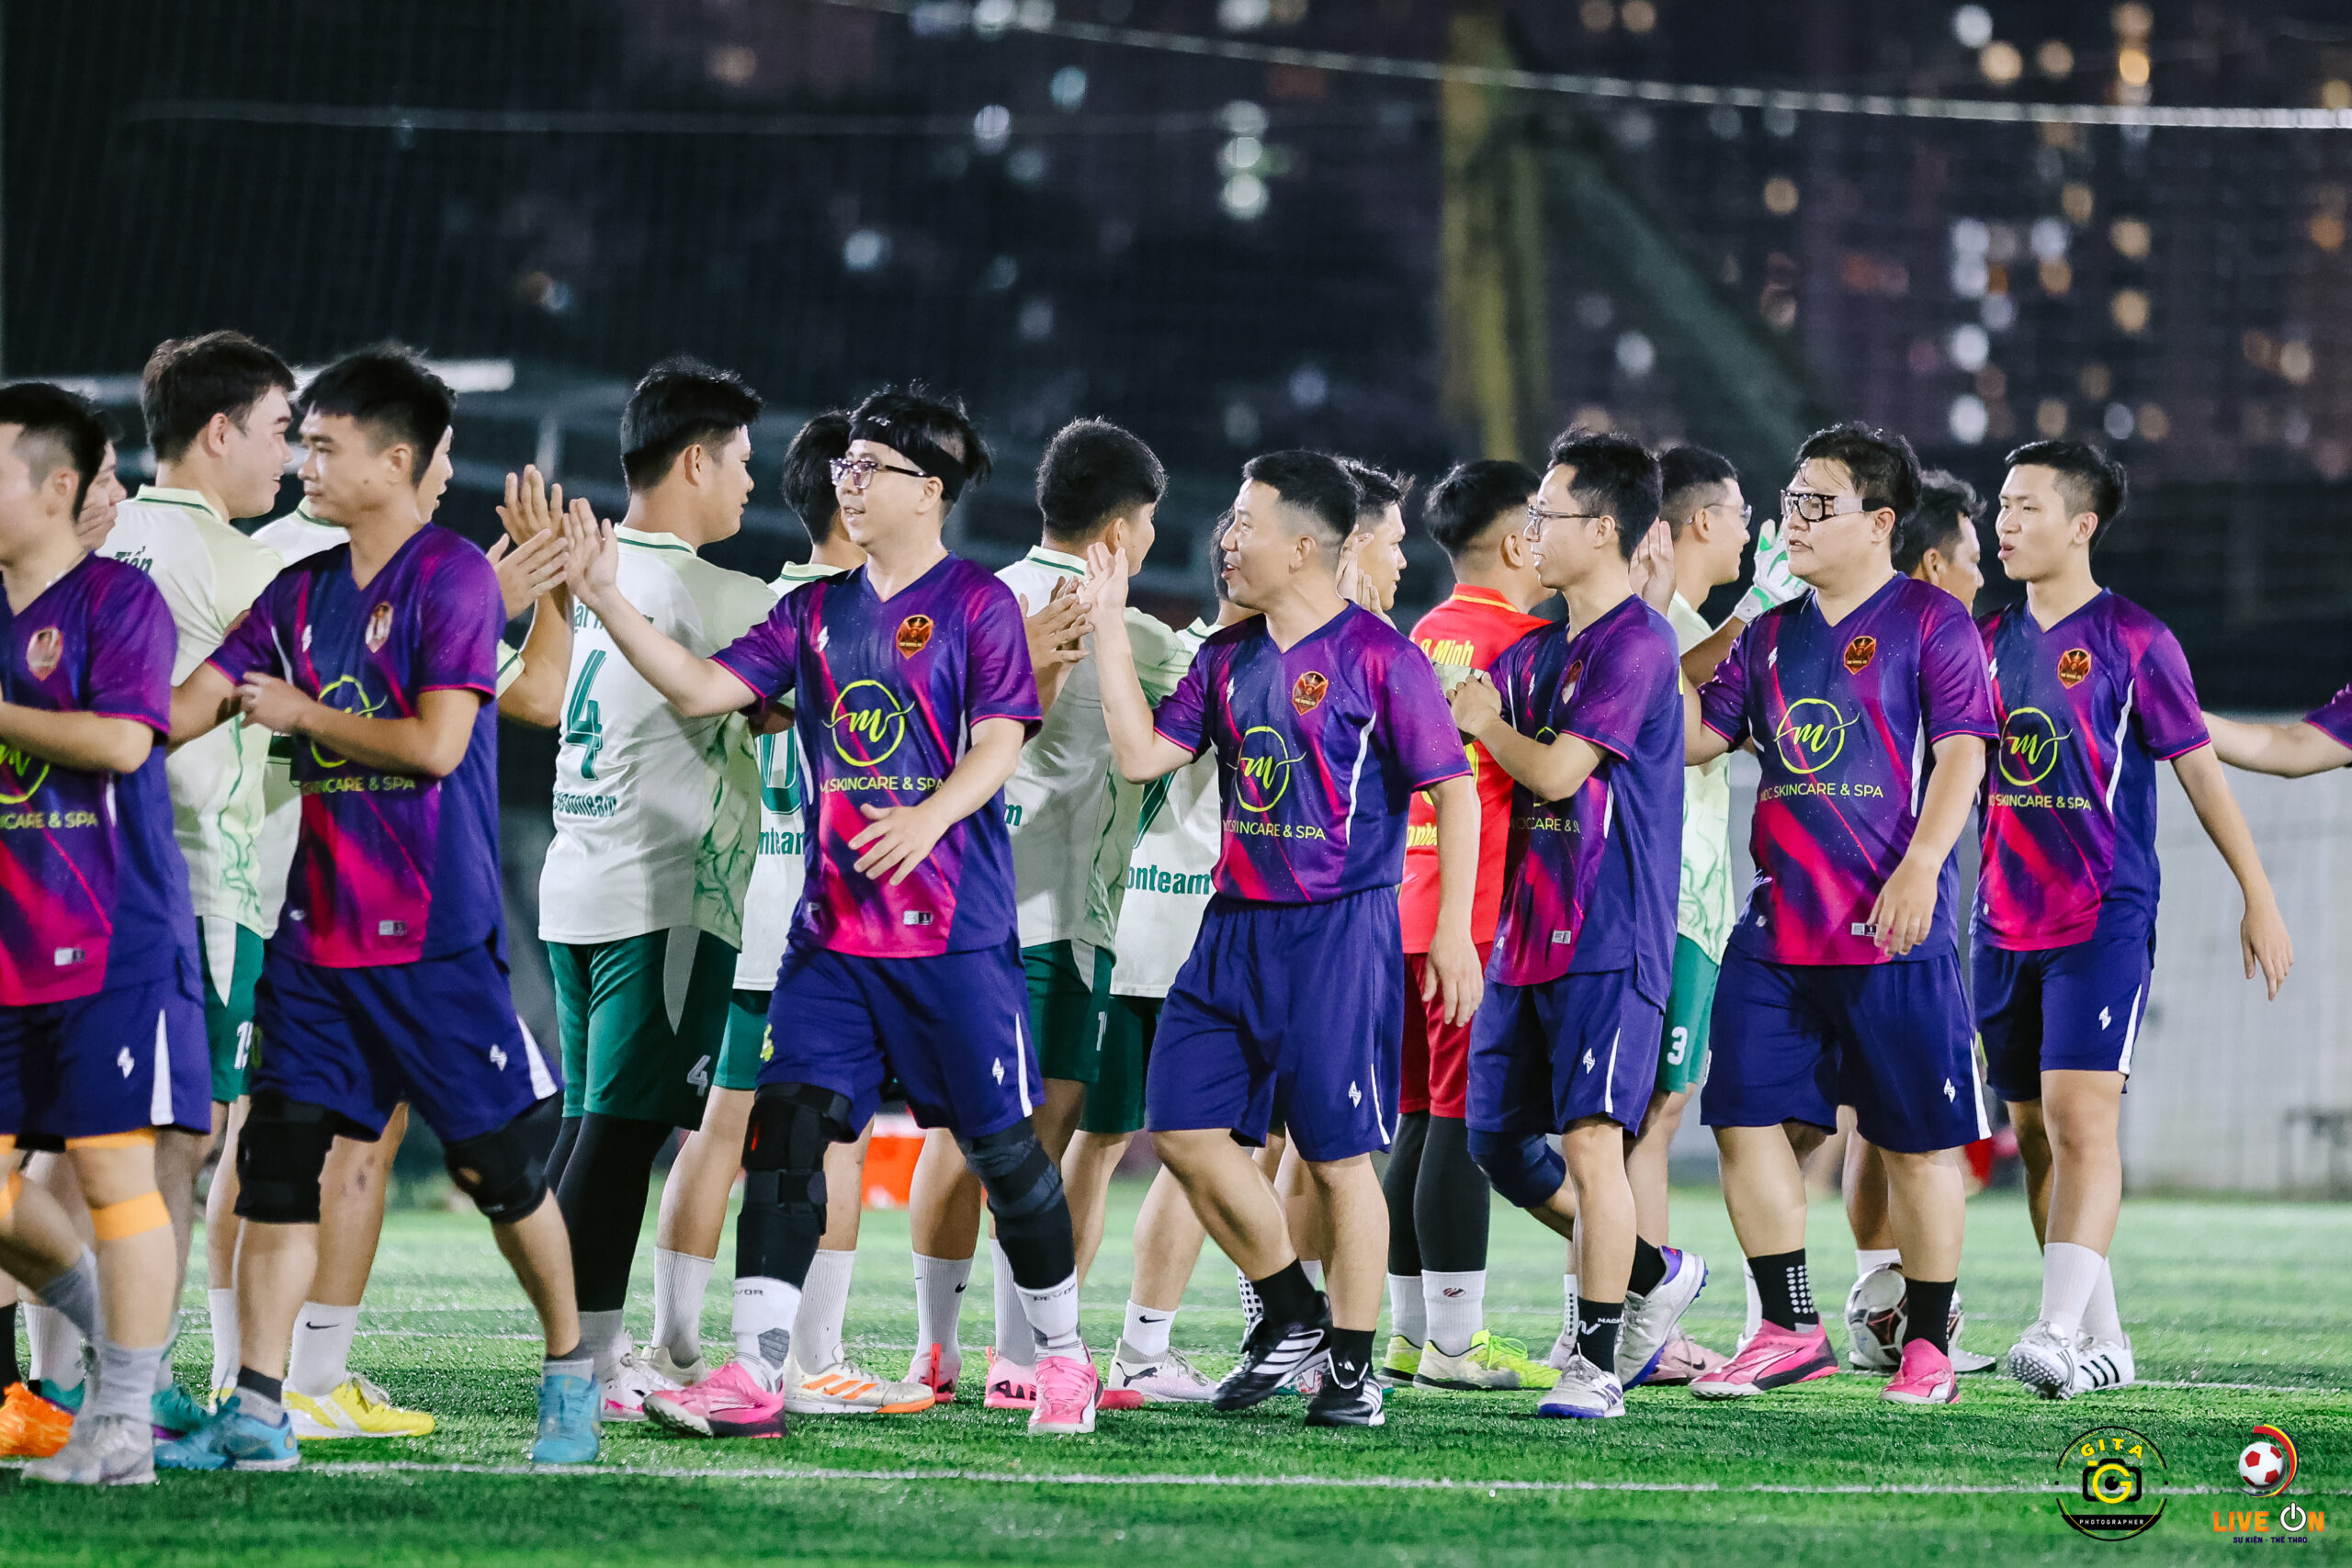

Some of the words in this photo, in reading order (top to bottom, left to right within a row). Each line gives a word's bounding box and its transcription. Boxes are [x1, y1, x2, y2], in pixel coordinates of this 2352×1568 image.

[565, 649, 603, 782] 4
[382, 775, 415, 791] SPA
[830, 776, 899, 793] SKINCARE
[902, 776, 913, 791] &
[1774, 783, 1837, 798] SKINCARE
[1839, 783, 1850, 796] &
[1853, 784, 1884, 799] SPA
[1996, 794, 2053, 808] SKINCARE
[2056, 795, 2065, 808] &
[2067, 796, 2093, 812] SPA
[64, 810, 98, 829] SPA
[1283, 824, 1293, 839] &
[1295, 825, 1327, 841] SPA
[1668, 1026, 1689, 1066] 3
[686, 1055, 711, 1096] 4
